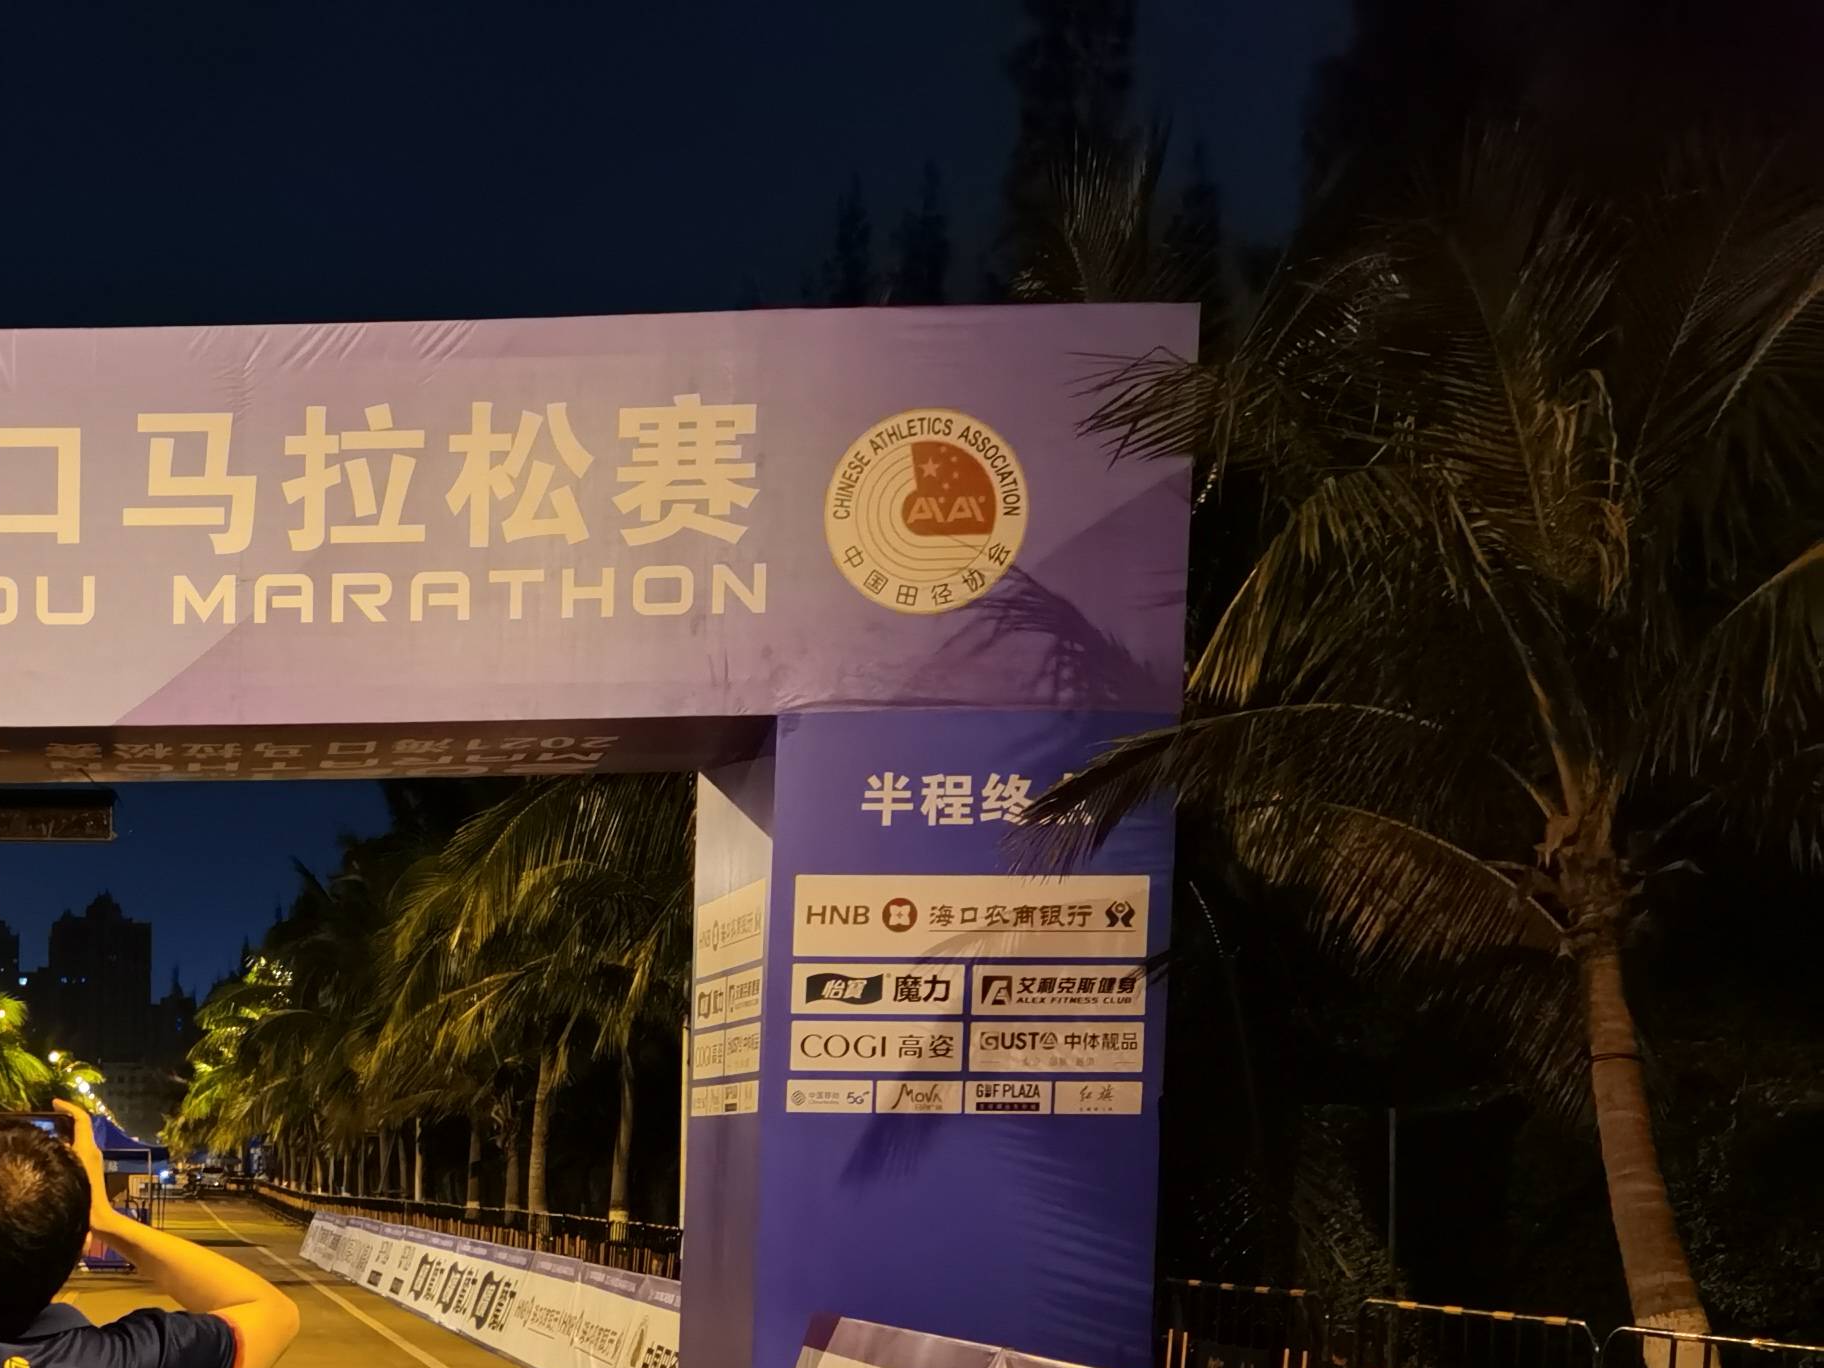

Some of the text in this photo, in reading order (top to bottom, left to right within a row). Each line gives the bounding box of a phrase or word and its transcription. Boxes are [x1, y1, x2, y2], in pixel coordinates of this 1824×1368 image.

[833, 417, 1021, 520] CHINESE ATHLETICS ASSOCIATION
[844, 543, 1011, 606] 中国田径协会
[170, 562, 770, 625] MARATHON
[861, 771, 1093, 826] 半程终
[806, 906, 870, 926] HNB
[929, 904, 1093, 928] 海口农商银行
[893, 974, 951, 1003] 魔力
[1016, 976, 1136, 994] 艾利克斯健身
[1102, 997, 1132, 1005] CLUB
[800, 1033, 954, 1059] COGI 高姿
[1003, 1083, 1040, 1098] PLAZA
